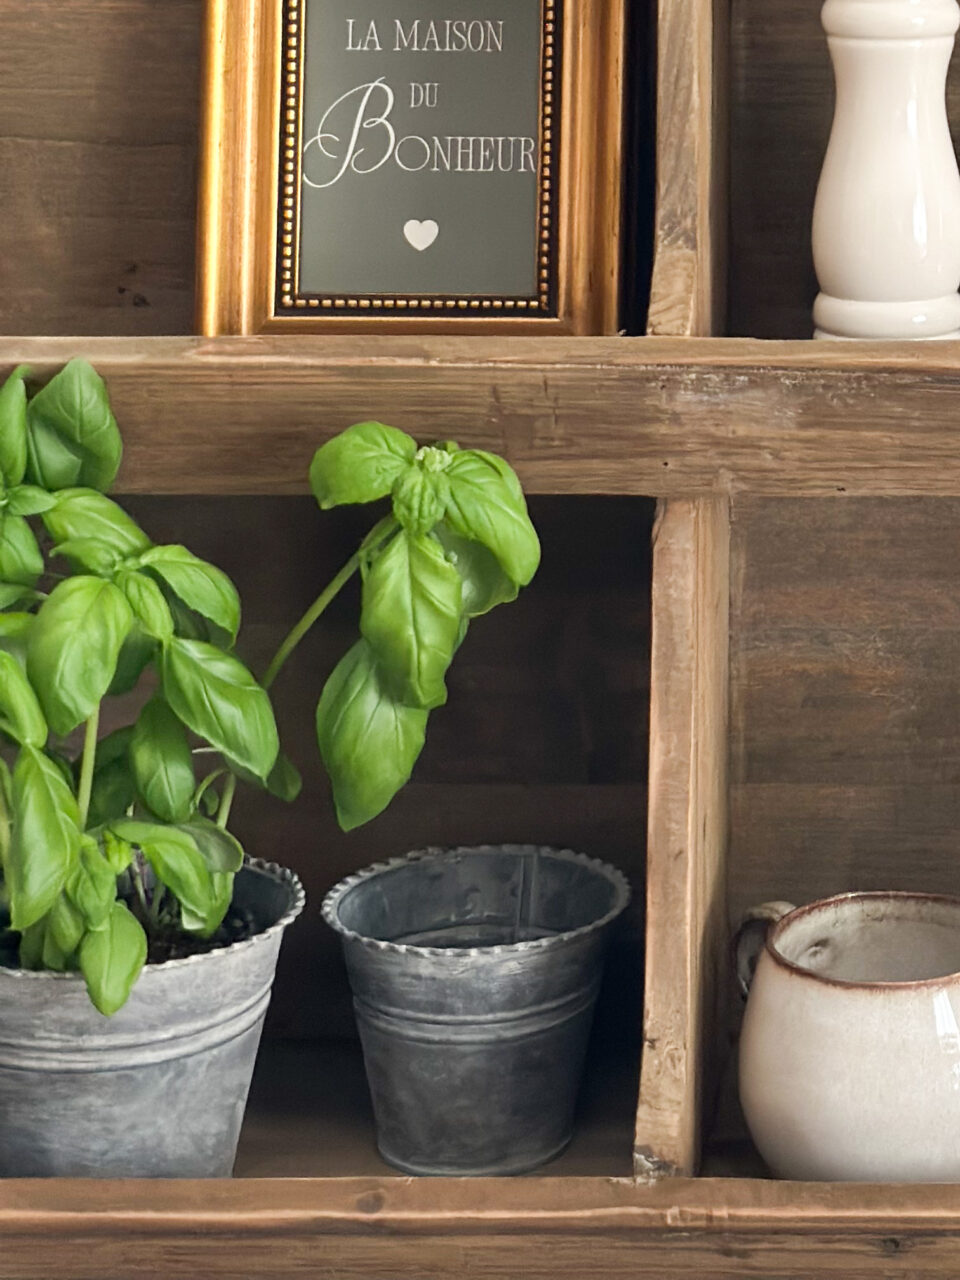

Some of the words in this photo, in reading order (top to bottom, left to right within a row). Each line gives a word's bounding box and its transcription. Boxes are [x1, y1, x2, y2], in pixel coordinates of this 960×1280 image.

[344, 18, 383, 52] LA
[393, 19, 505, 53] MAISON
[409, 82, 440, 109] DU
[302, 76, 537, 188] BONHEUR
